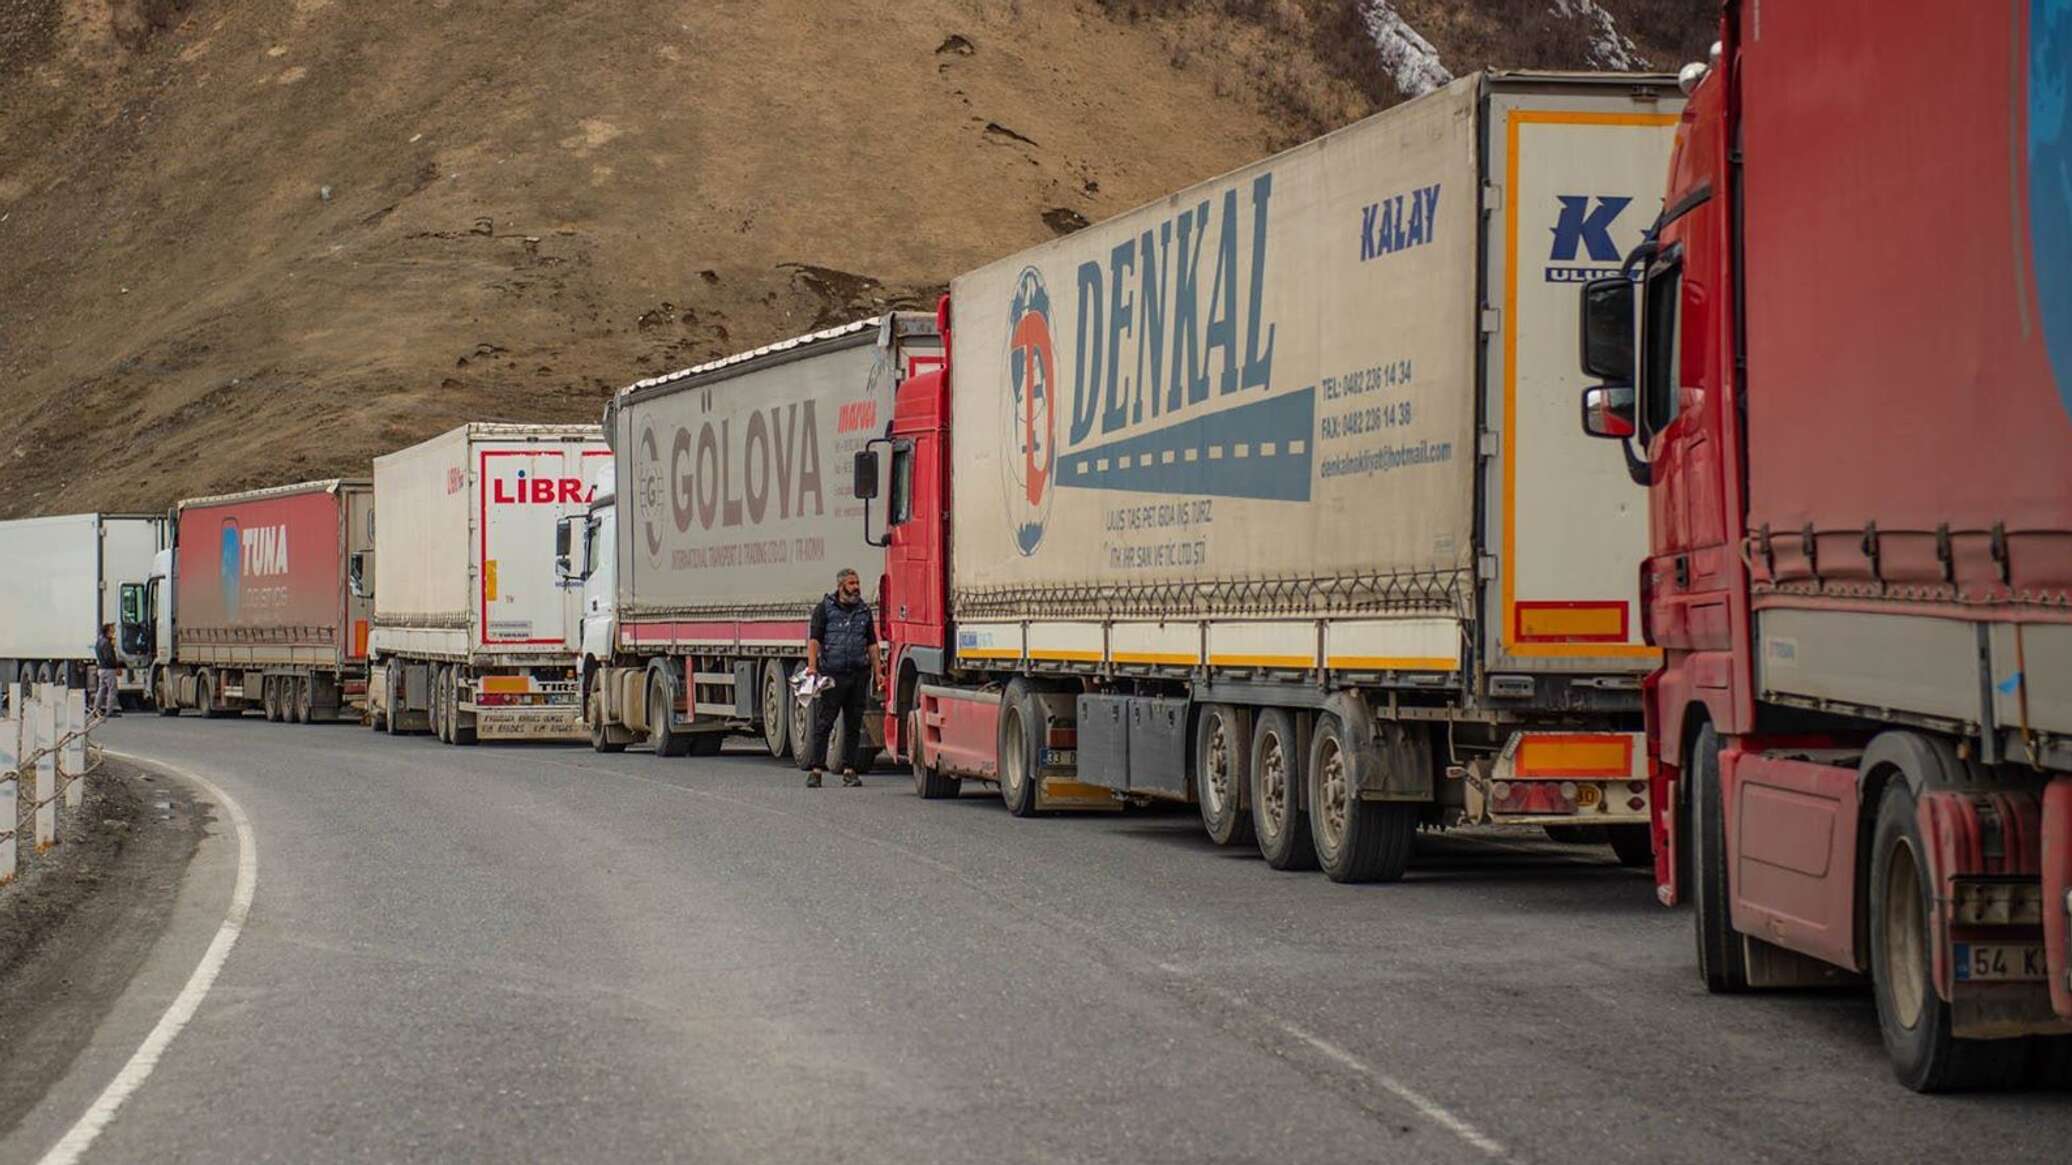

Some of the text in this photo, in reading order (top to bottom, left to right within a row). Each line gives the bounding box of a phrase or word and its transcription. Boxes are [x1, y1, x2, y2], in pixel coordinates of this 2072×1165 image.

[1360, 183, 1441, 261] KALAY
[1549, 195, 1665, 261] K
[1069, 172, 1275, 446] DENKAL
[1384, 362, 1396, 387] 14
[1399, 360, 1411, 384] 34
[1384, 403, 1396, 428] 14
[671, 390, 825, 533] GÖLOVA
[242, 524, 288, 576] TUNA
[1975, 947, 2007, 975] 54
